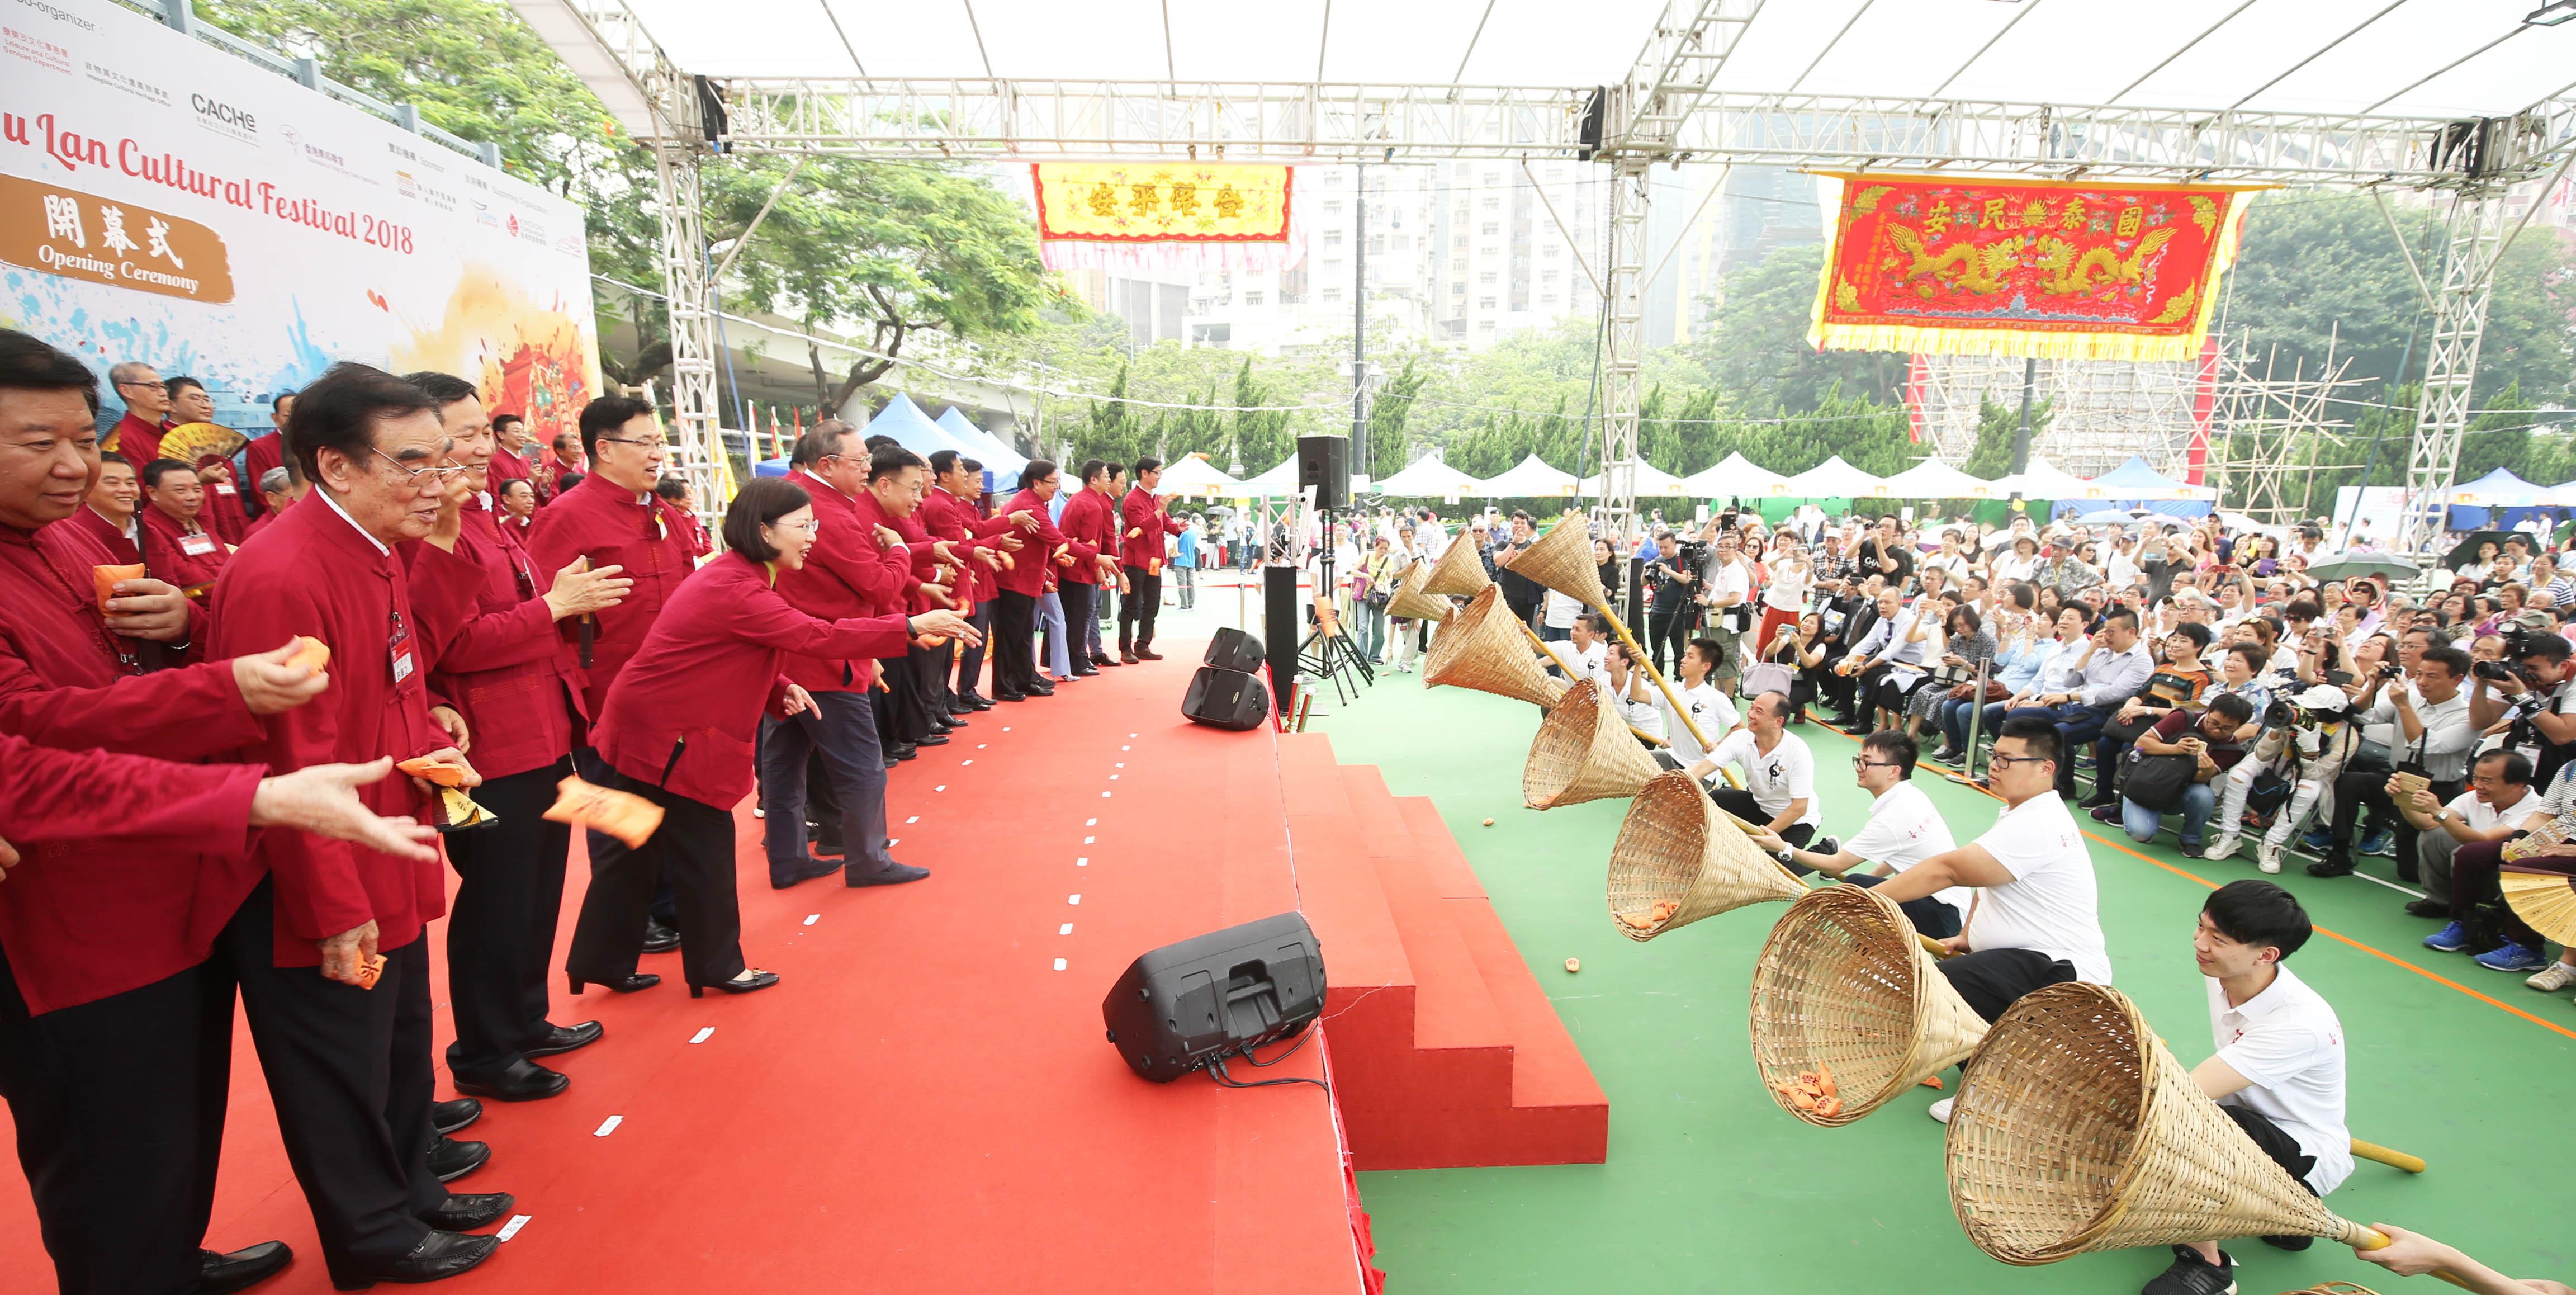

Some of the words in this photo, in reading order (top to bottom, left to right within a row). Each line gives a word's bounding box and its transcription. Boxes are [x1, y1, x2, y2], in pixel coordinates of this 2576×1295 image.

[16, 0, 96, 32] o-organizer
[3, 46, 32, 62] Services
[33, 56, 72, 75] Department
[5, 37, 29, 52] Leisure
[31, 48, 43, 57] and
[45, 53, 70, 67] Cultural
[36, 114, 110, 171] Lan
[118, 138, 253, 210] Cultural
[258, 182, 357, 239] Festival
[363, 215, 414, 255] 2018
[43, 194, 184, 270] 開幕式
[38, 244, 116, 278] Opening
[121, 261, 199, 294] Ceremony
